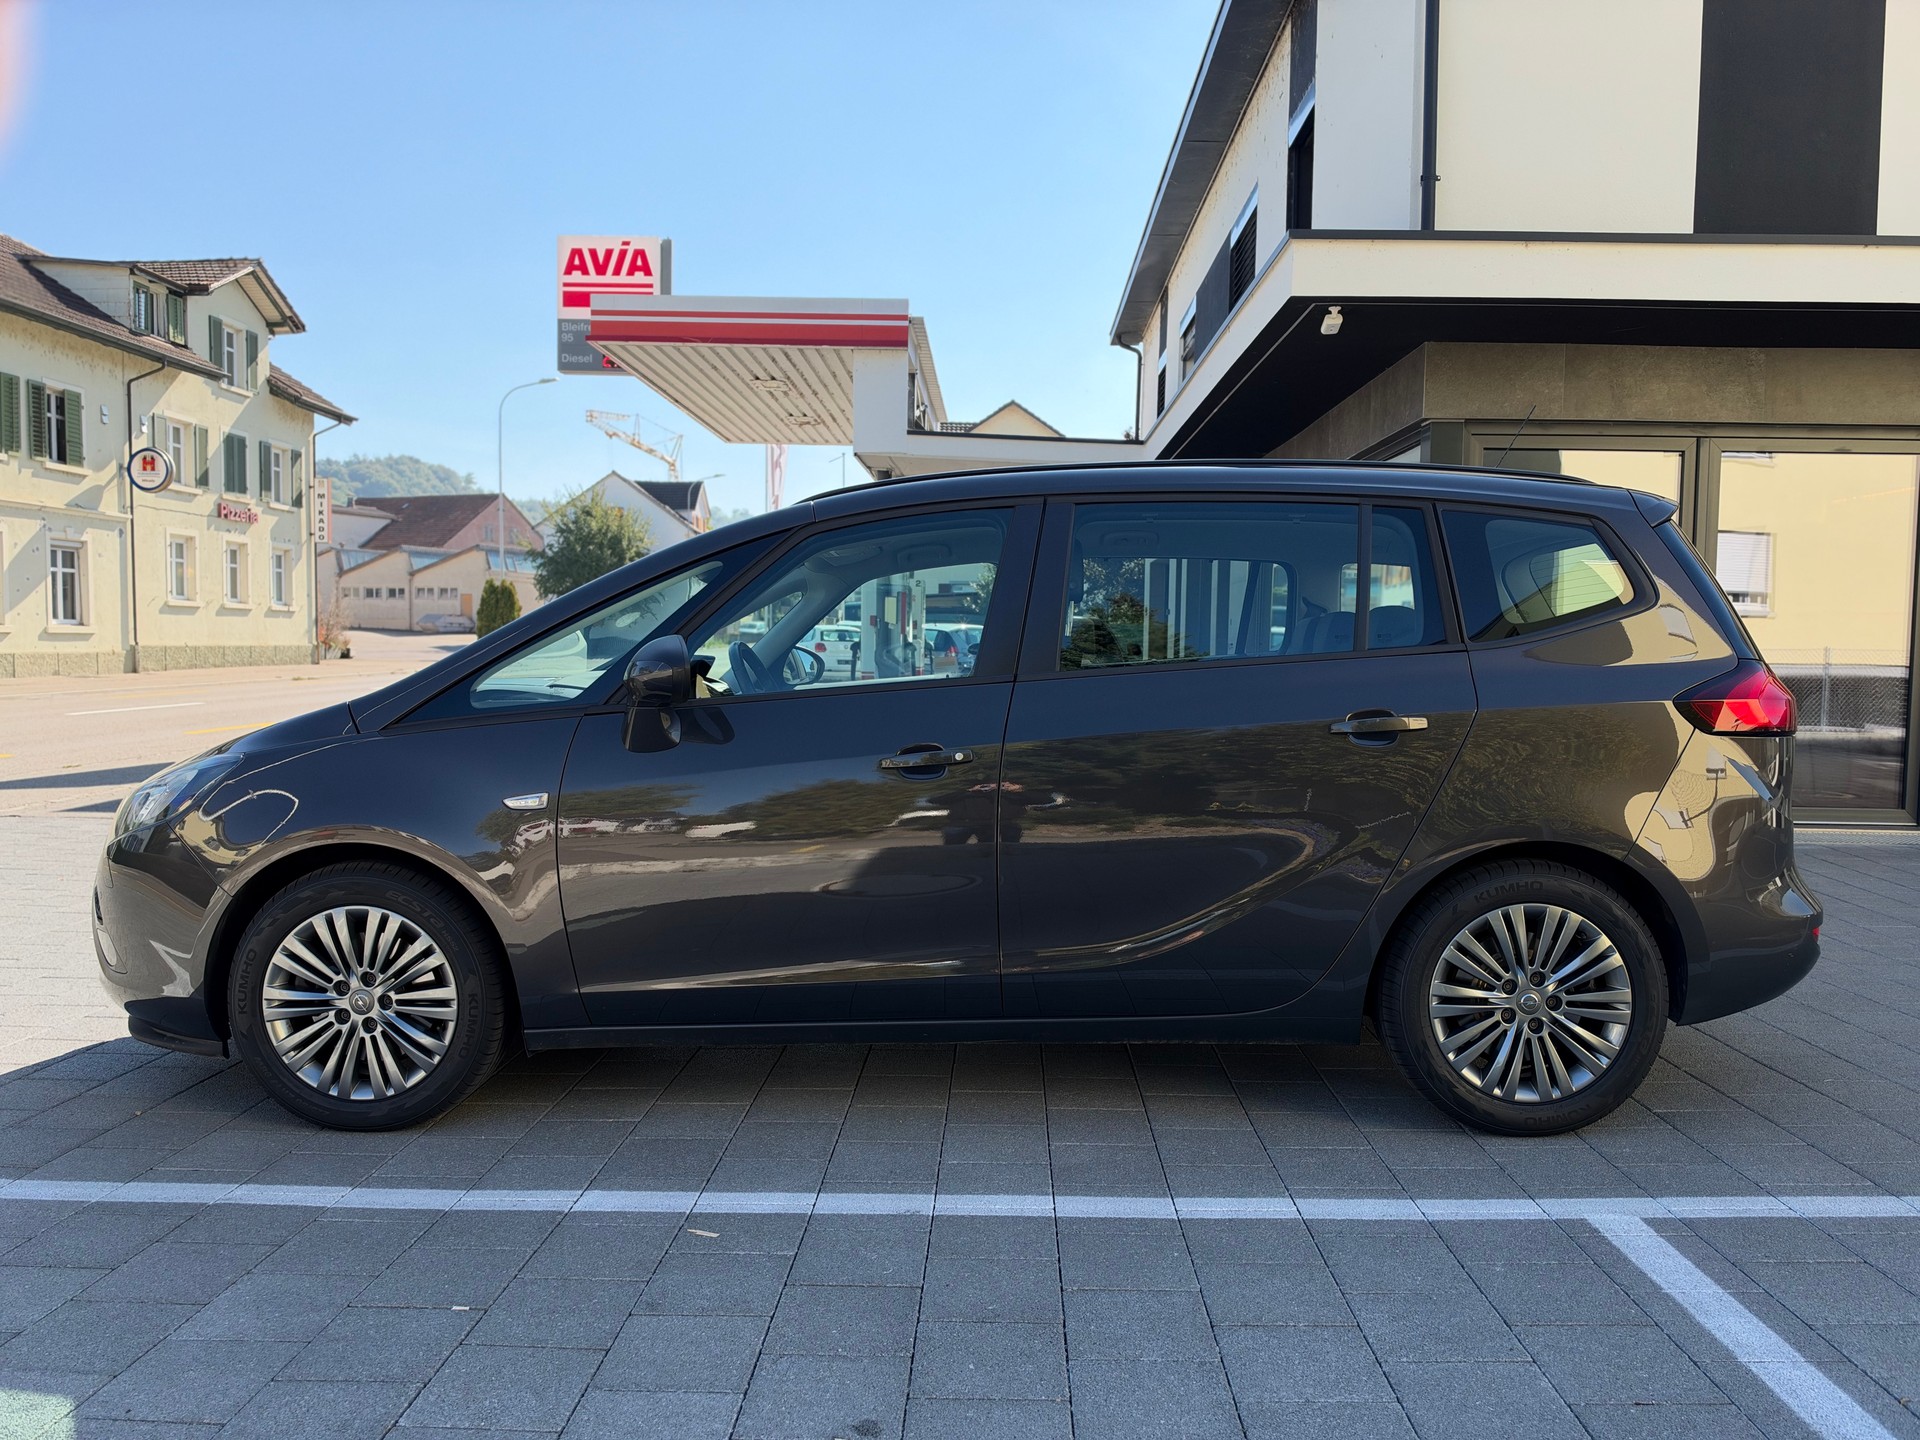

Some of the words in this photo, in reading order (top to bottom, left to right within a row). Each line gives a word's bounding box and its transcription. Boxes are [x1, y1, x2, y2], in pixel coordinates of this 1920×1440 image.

[563, 241, 653, 276] AVIA
[561, 333, 574, 342] 95
[561, 354, 593, 363] Diesel
[219, 502, 260, 525] Pizzeria
[317, 493, 326, 541] MIKADO
[1473, 881, 1544, 904] KUMHO
[237, 948, 258, 1015] KUMHO
[457, 993, 480, 1060] KUMHO
